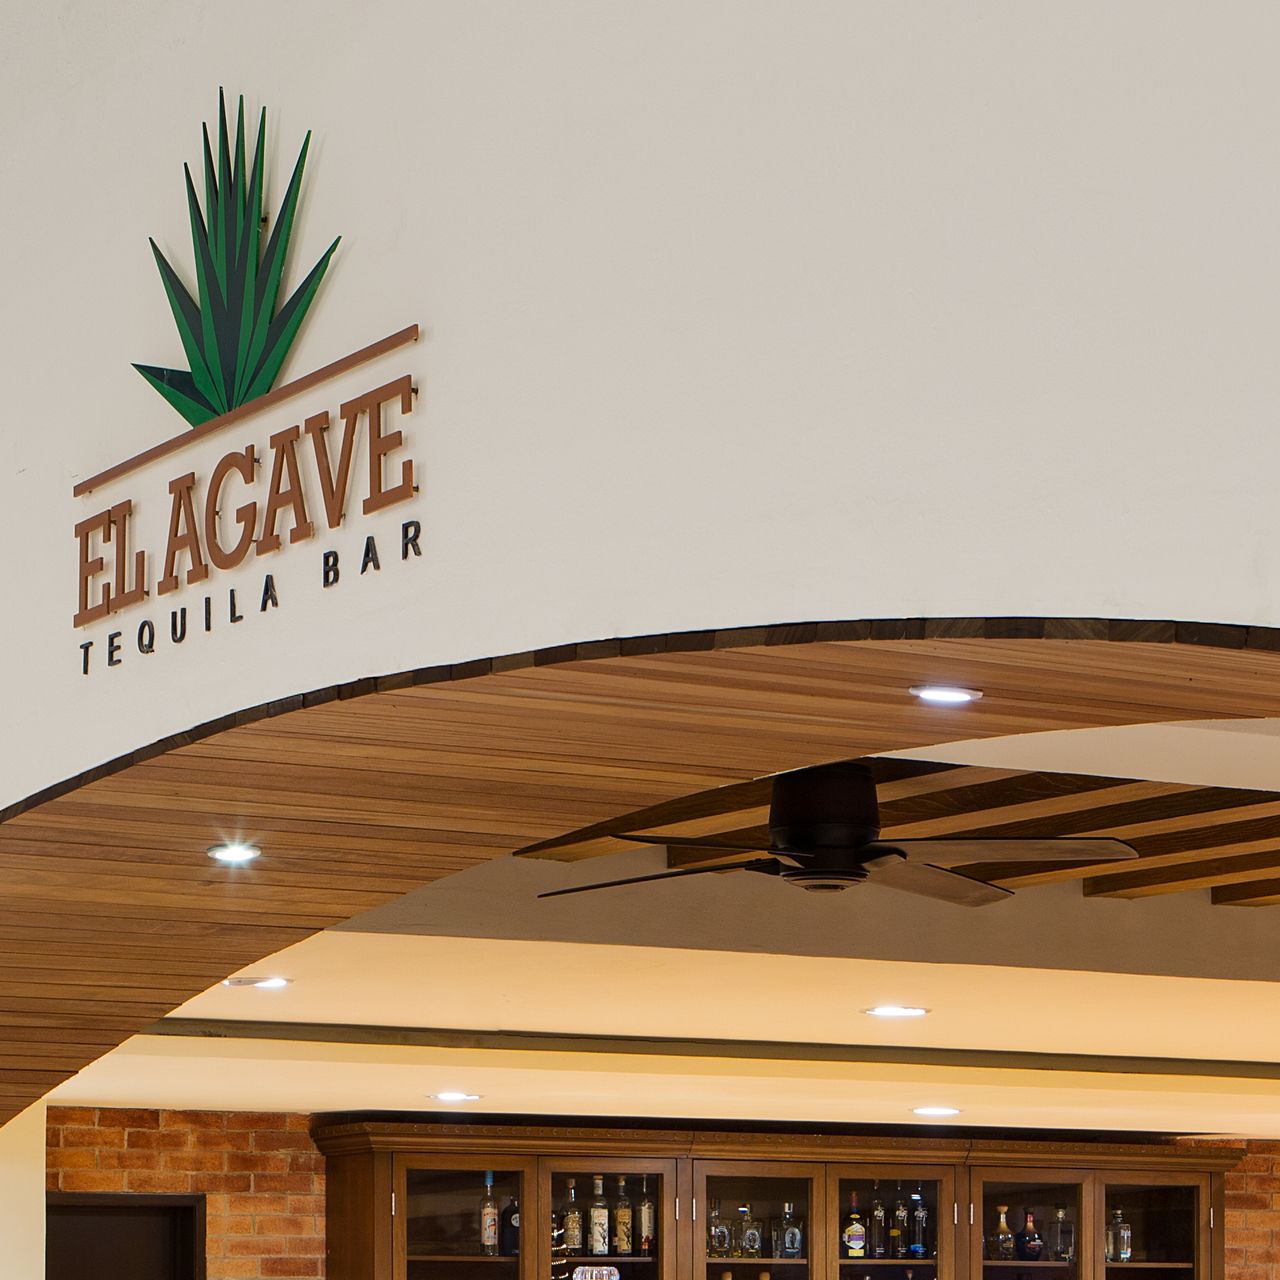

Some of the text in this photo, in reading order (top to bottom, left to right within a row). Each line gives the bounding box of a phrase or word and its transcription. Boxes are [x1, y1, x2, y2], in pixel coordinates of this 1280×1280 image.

[73, 373, 414, 628] EL AGAVE
[79, 520, 423, 676] TEQUILA BAR
